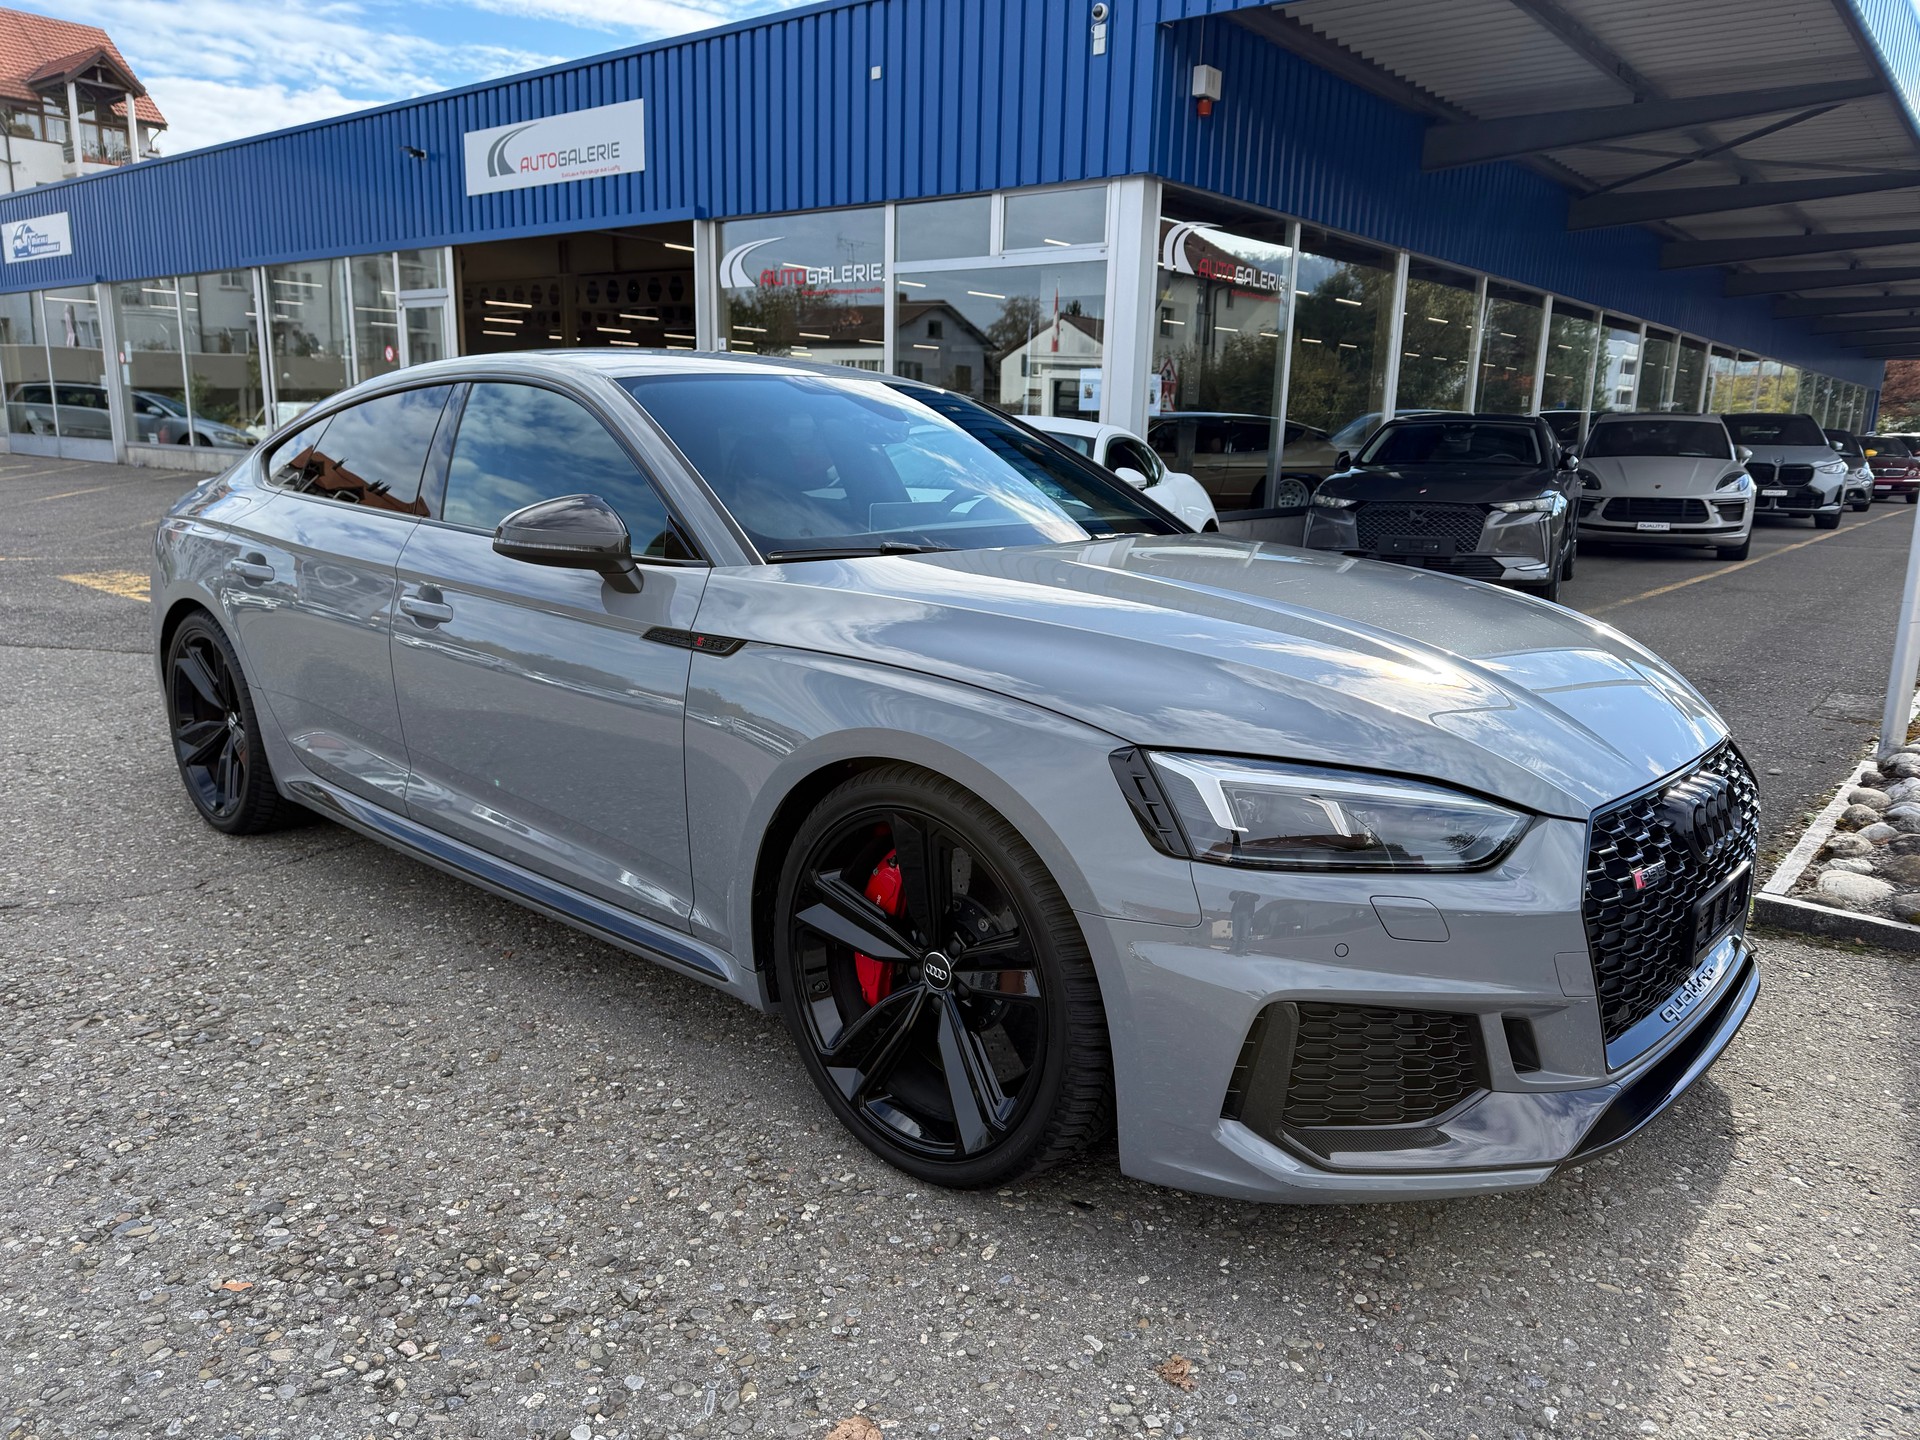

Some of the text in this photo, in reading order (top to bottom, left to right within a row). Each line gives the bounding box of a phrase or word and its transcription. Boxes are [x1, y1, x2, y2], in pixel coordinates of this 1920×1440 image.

[520, 141, 620, 173] AUTOGALERIE
[760, 263, 883, 287] AUTOGALERIE
[1198, 258, 1287, 292] AUTOGALERIE
[1660, 965, 1714, 1023] quattro
